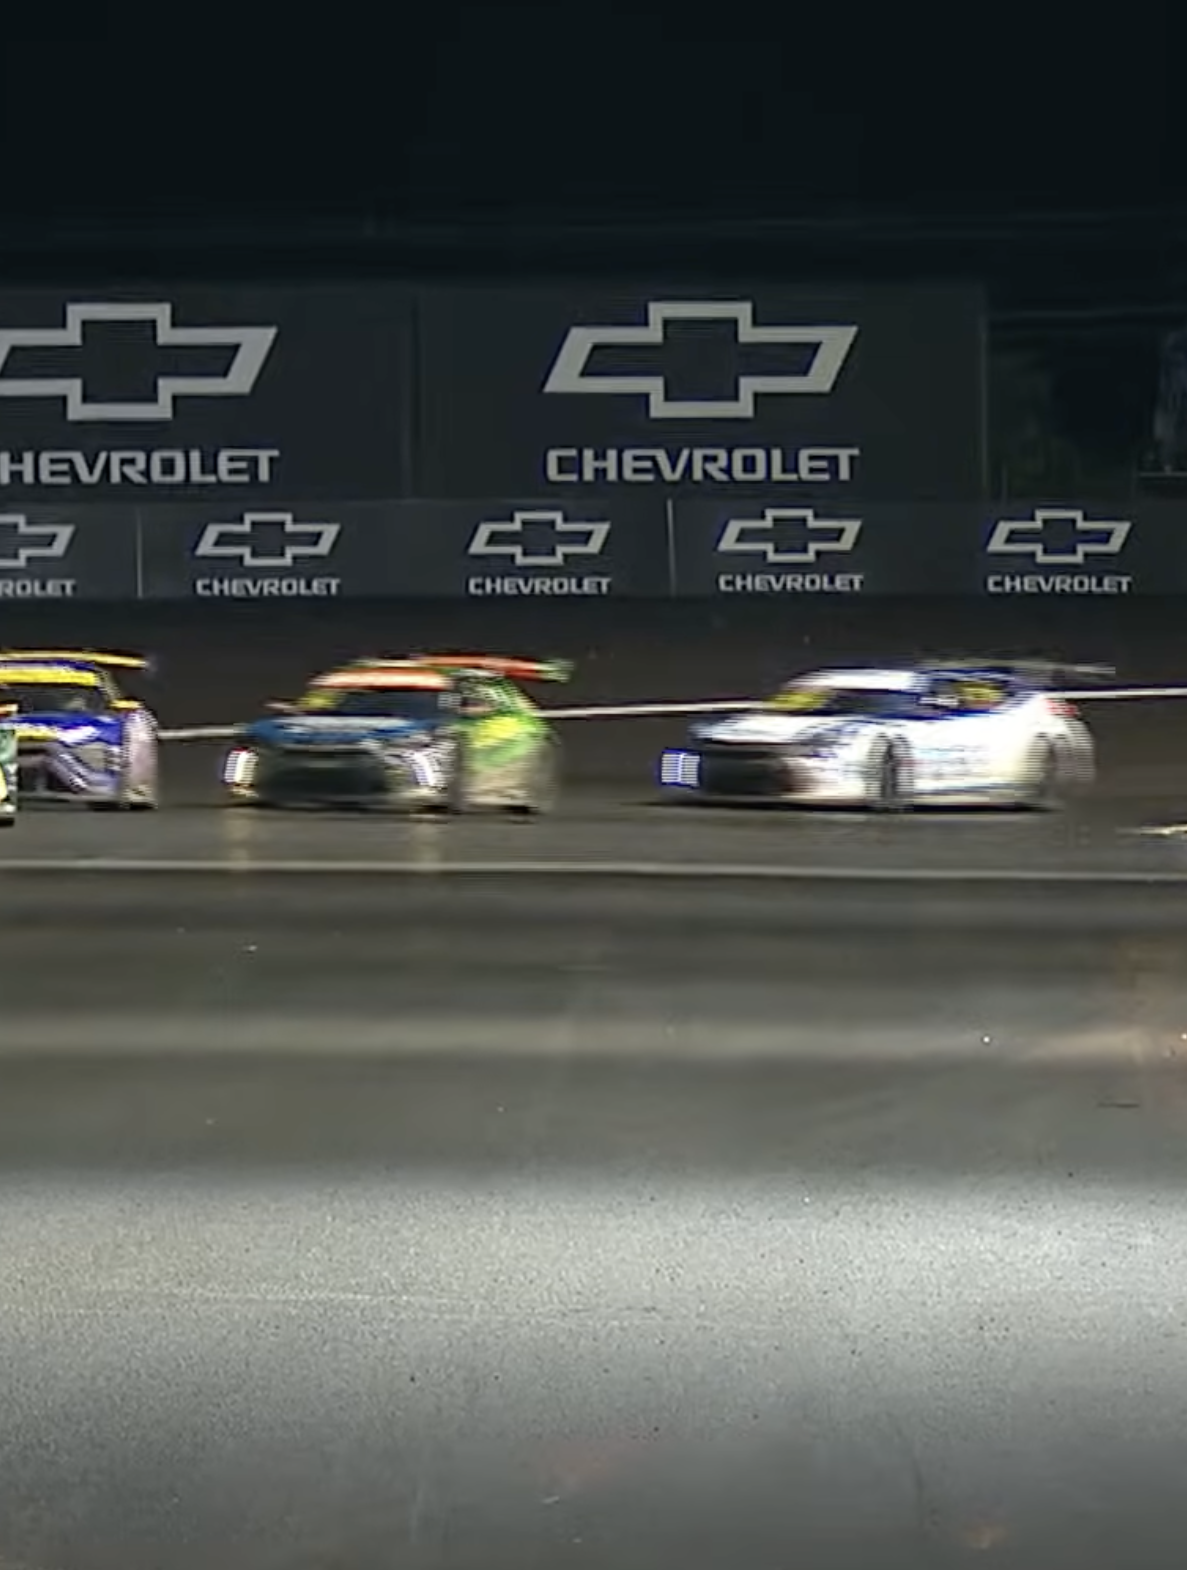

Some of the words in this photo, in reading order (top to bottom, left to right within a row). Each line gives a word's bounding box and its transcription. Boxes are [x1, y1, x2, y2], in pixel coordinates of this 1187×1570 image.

[546, 447, 860, 484] CHEVROLET
[195, 577, 341, 598] CHEVROLET
[468, 576, 612, 596] CHEVROLET
[718, 573, 864, 594] CHEVROLET
[986, 575, 1132, 595] CHEVROLET
